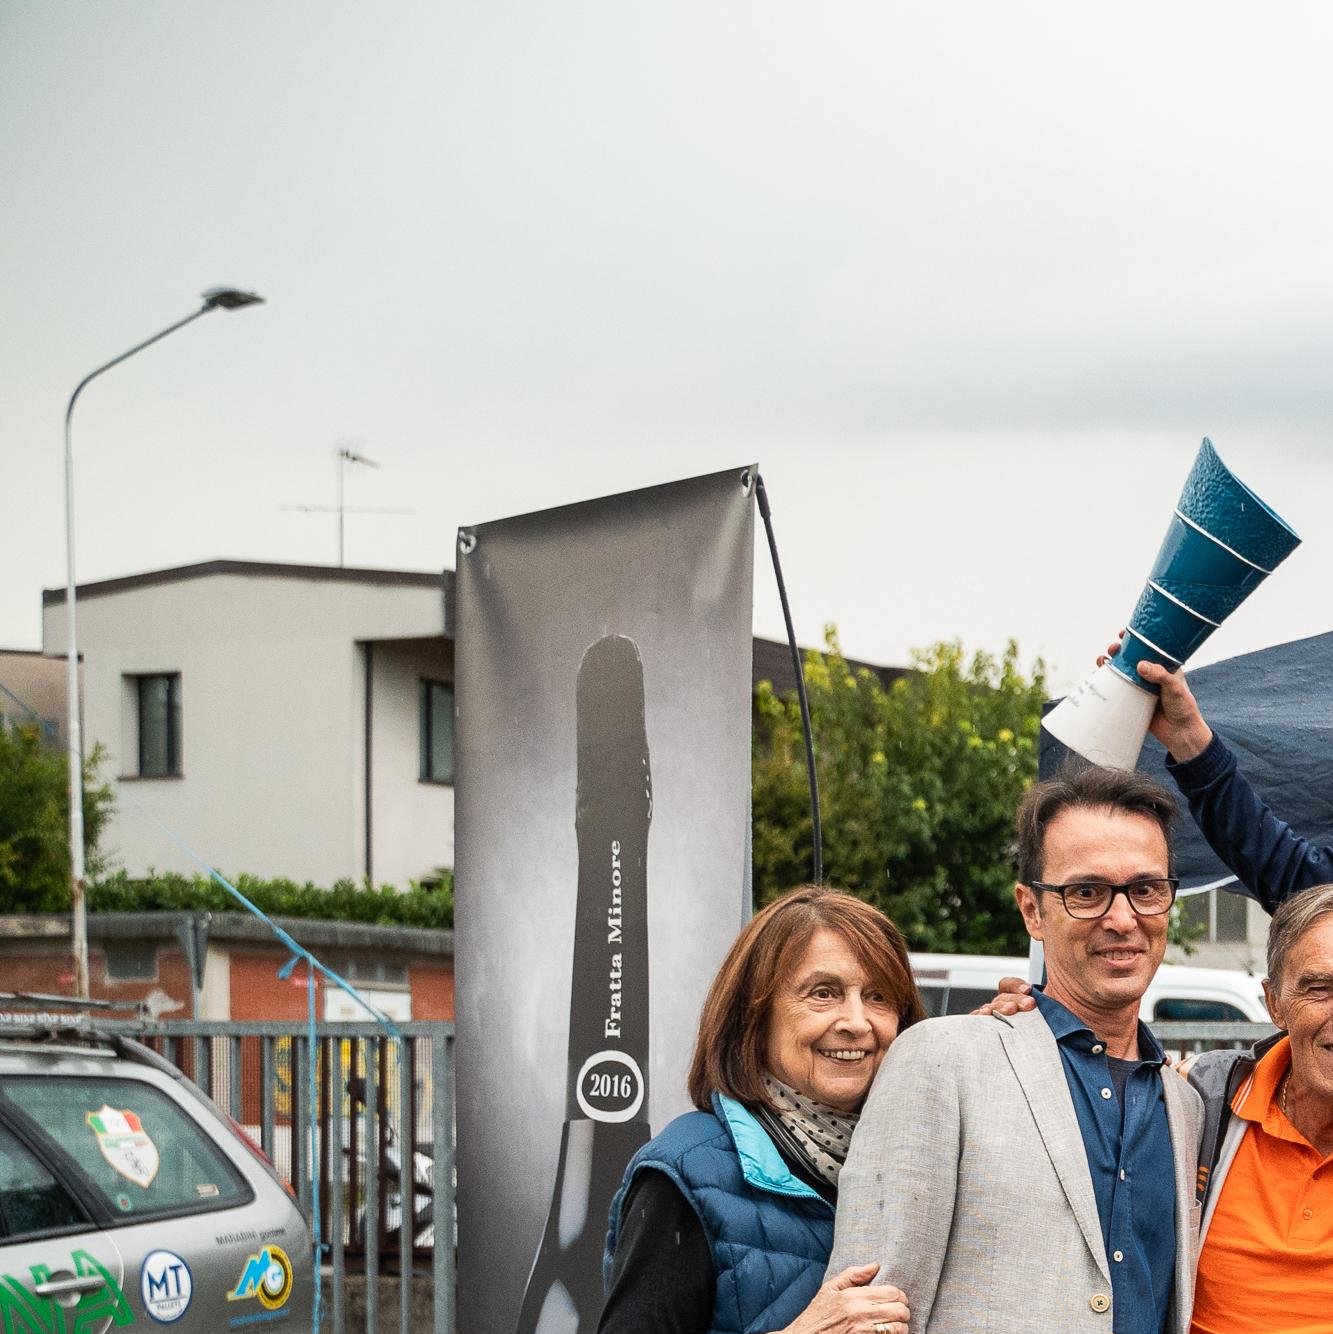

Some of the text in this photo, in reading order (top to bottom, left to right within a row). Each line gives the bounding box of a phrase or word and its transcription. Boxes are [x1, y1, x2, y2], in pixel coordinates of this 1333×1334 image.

[604, 839, 624, 1039] Fratta Minore
[590, 1073, 632, 1099] 2016
[147, 1264, 183, 1299] MT
